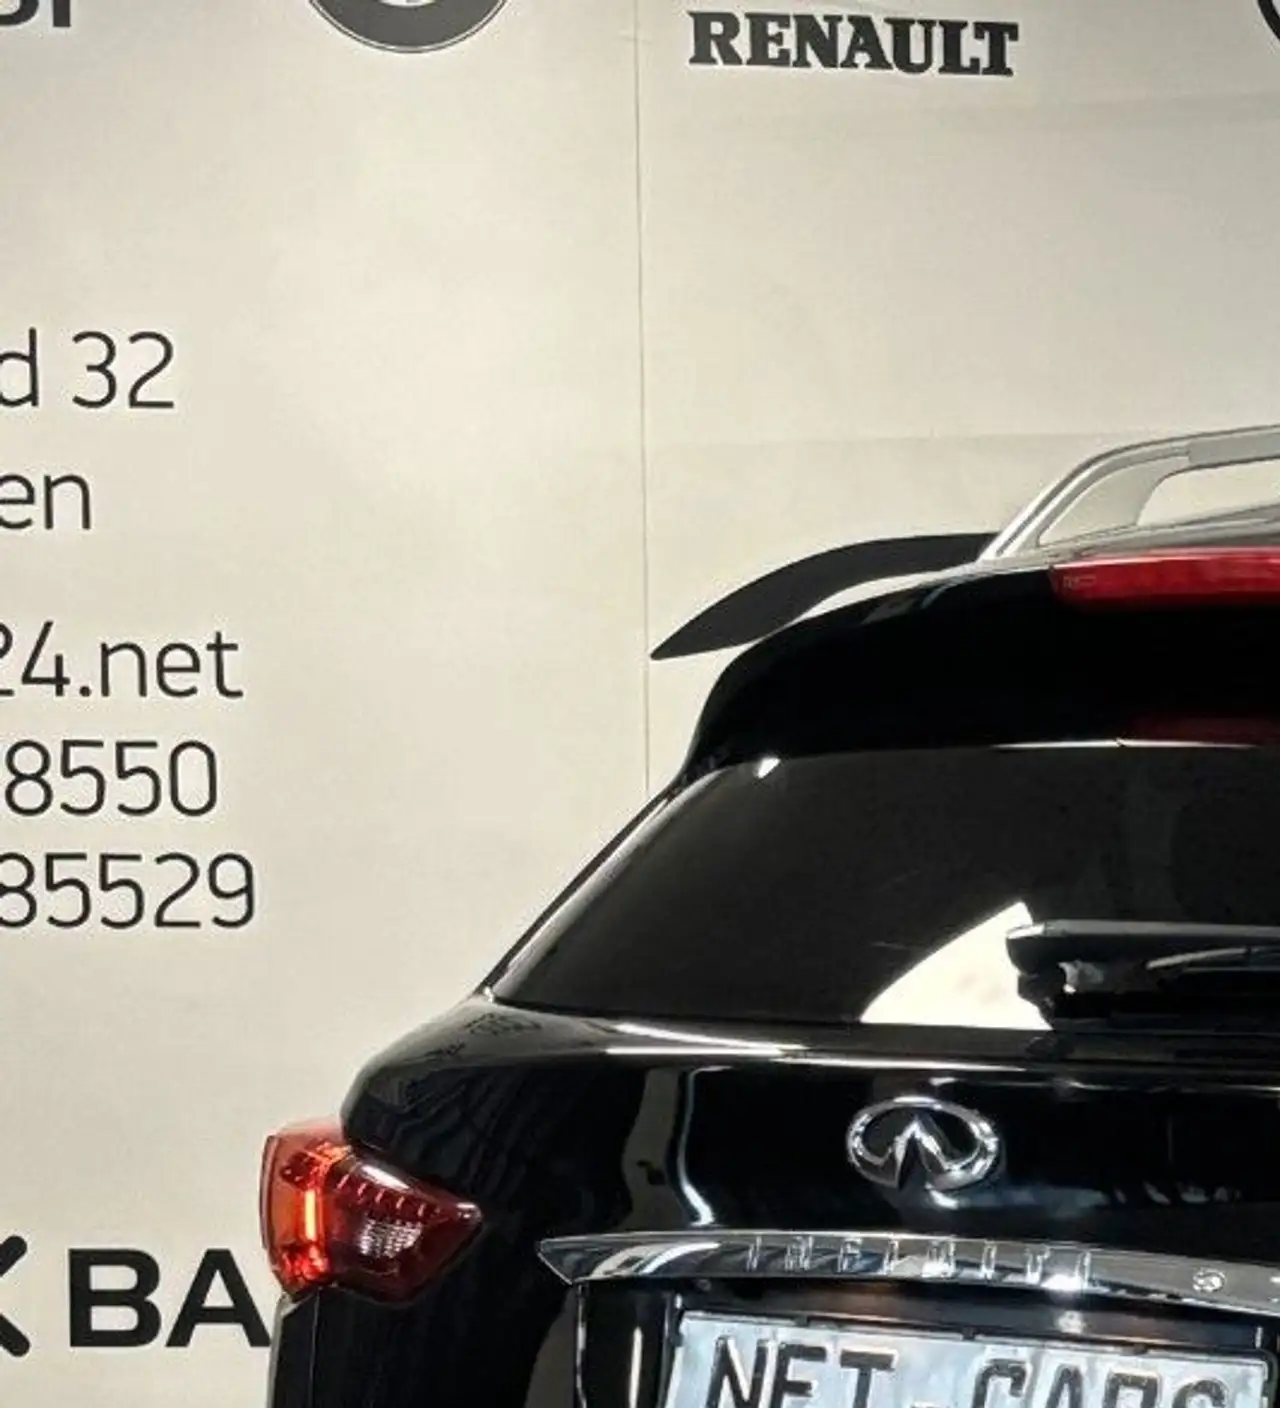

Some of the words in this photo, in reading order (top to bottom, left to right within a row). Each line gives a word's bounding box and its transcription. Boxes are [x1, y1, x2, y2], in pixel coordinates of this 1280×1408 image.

[688, 11, 1019, 77] RENAULT
[72, 331, 175, 409] 32
[5, 739, 217, 817] 8550
